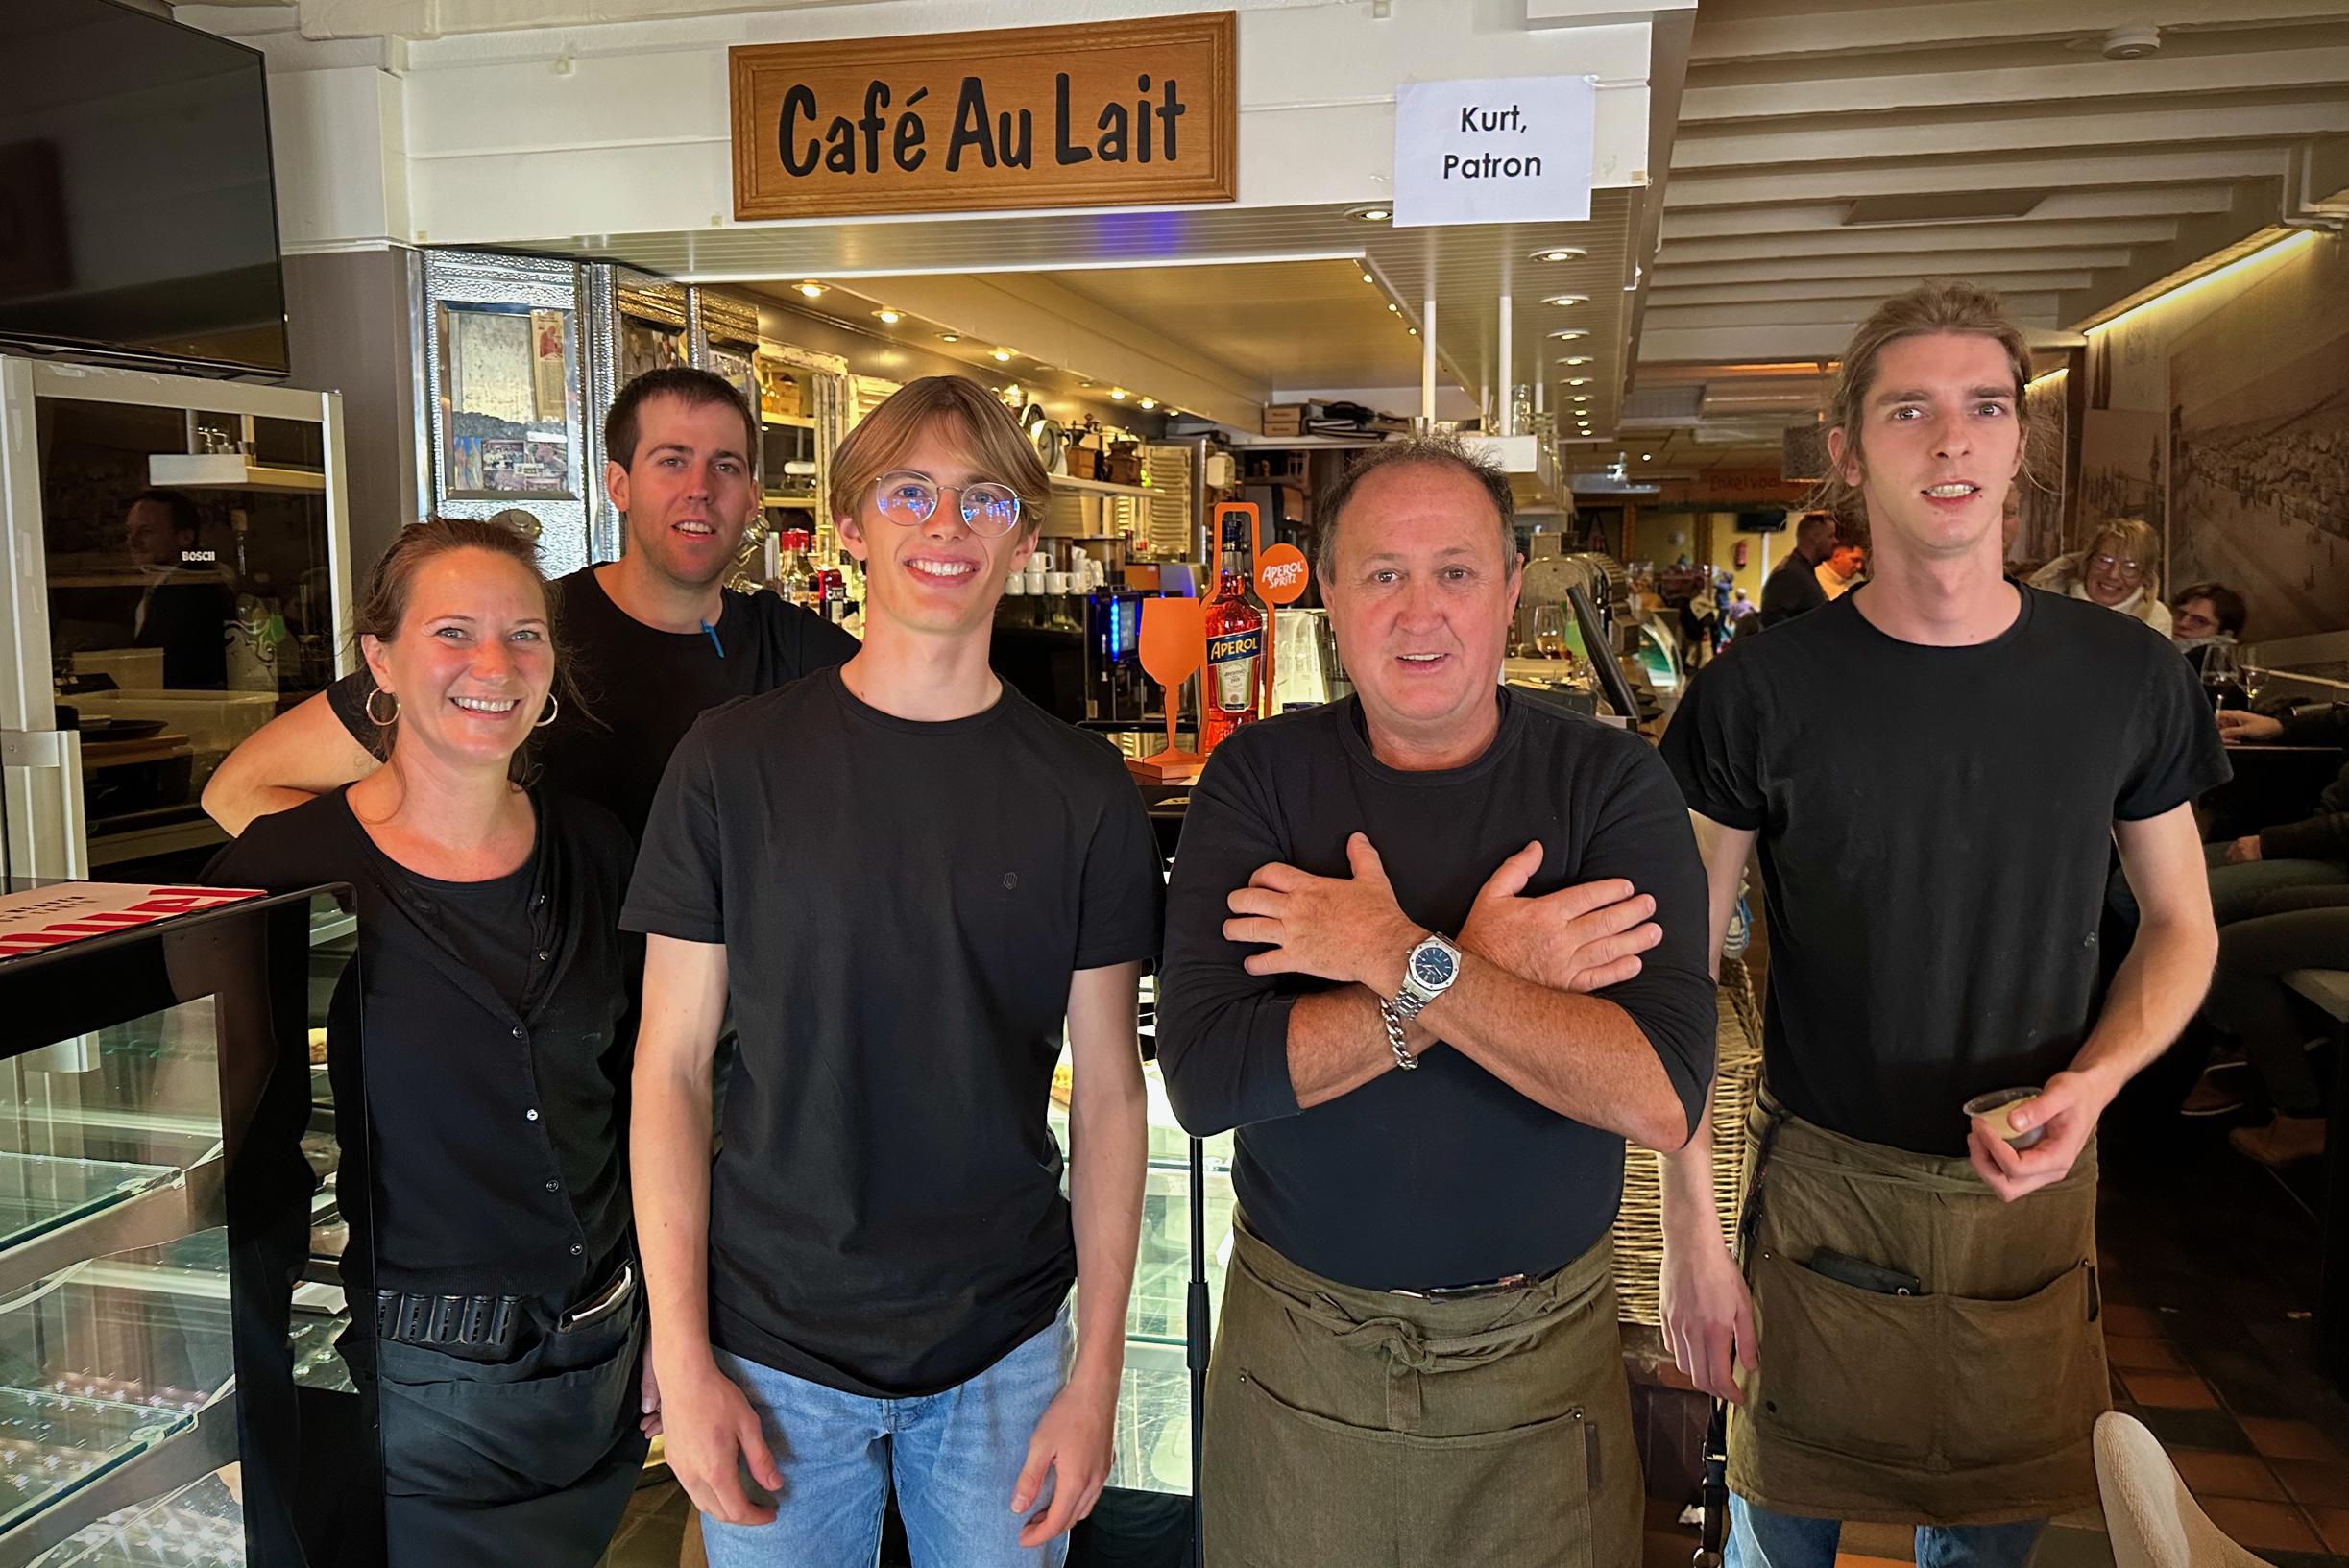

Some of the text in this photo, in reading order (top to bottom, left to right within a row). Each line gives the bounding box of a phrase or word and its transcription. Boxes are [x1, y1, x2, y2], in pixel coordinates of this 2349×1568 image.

[779, 72, 1186, 177] Café Au Lait
[1461, 104, 1527, 133] Kurt,
[1443, 152, 1541, 180] Patron
[182, 550, 215, 562] BOSCH
[1261, 561, 1303, 584] APEROL
[1210, 637, 1258, 661] APEROL
